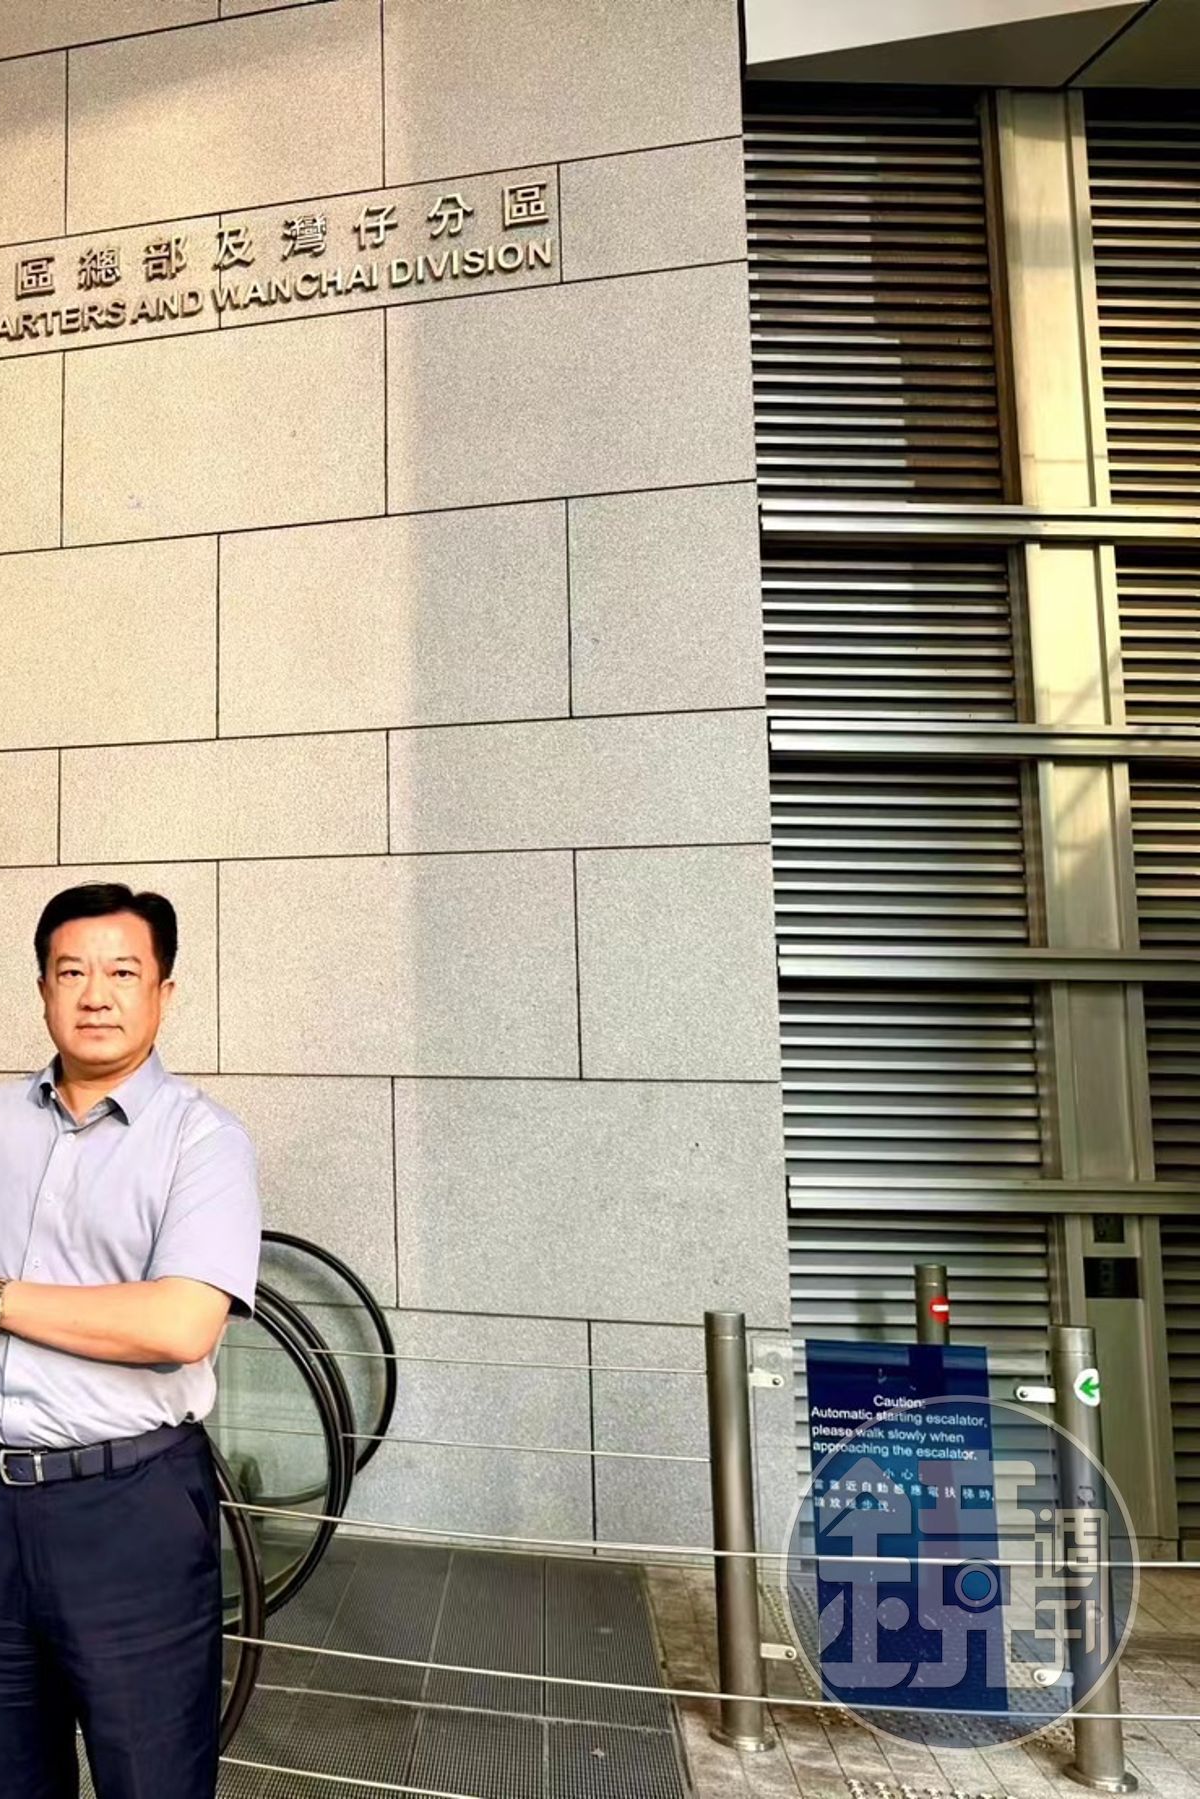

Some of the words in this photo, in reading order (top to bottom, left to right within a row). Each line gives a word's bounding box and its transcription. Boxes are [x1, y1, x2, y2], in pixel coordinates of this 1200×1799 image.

[130, 286, 204, 326] AND
[212, 262, 378, 312] WANCHAI
[389, 238, 553, 290] DIVISION
[873, 1394, 926, 1408] Caution:
[811, 1406, 873, 1420] Automatic
[876, 1411, 922, 1425] starting
[811, 1424, 853, 1438] please
[856, 1427, 885, 1439] walk
[887, 1429, 927, 1444] slowly
[929, 1431, 965, 1444] when
[812, 1441, 890, 1458] approaching
[892, 1444, 913, 1456] the
[915, 1448, 977, 1461] escalator.
